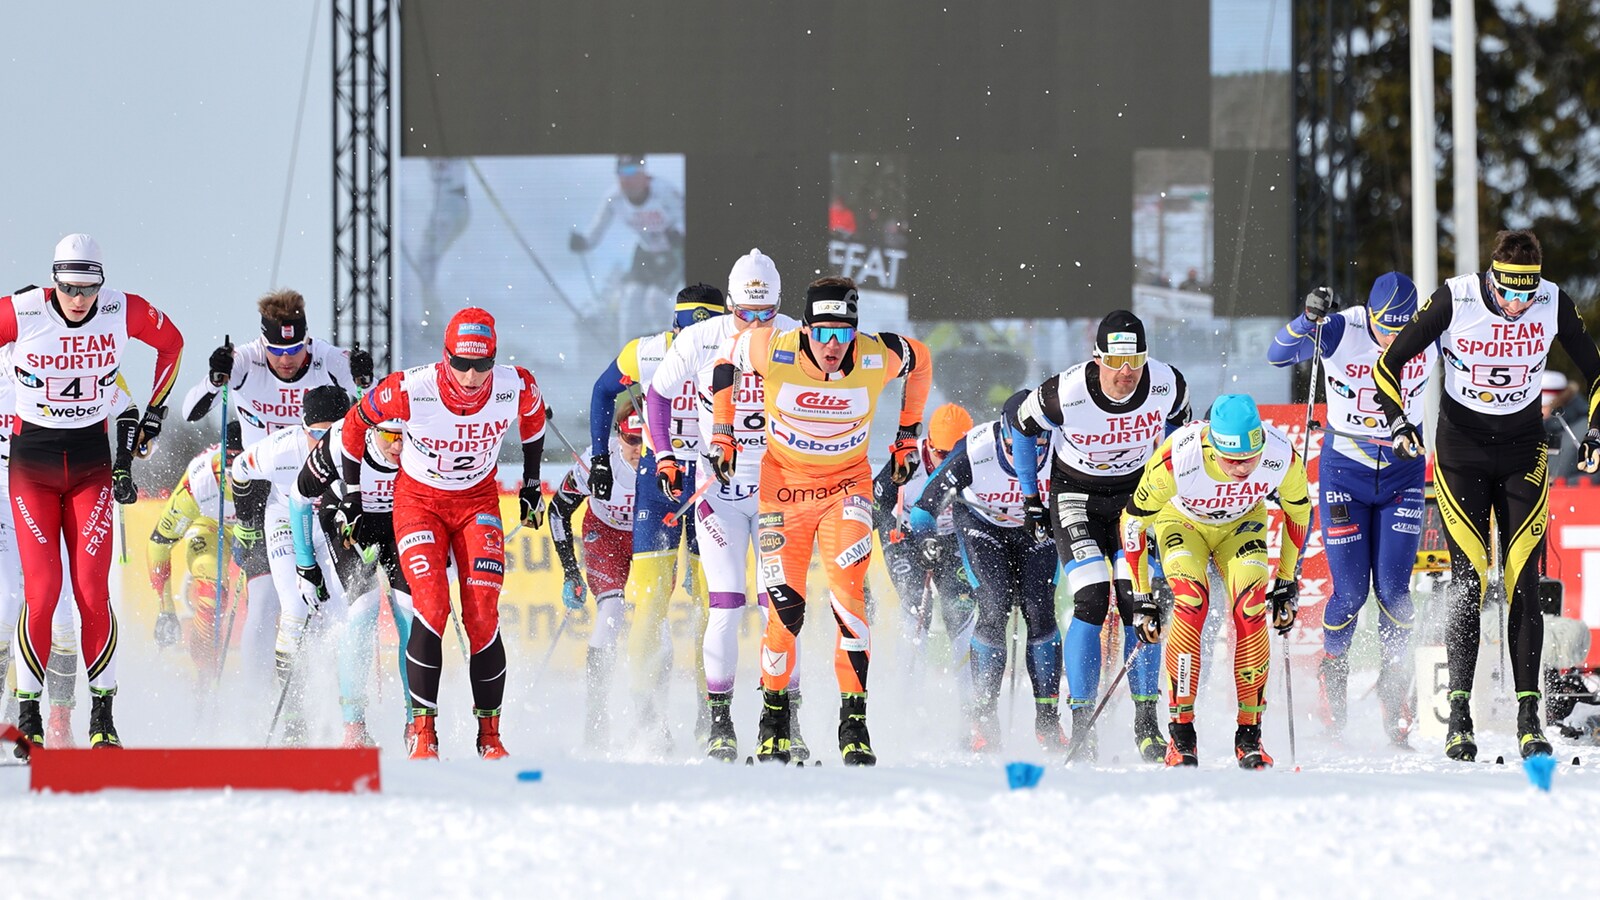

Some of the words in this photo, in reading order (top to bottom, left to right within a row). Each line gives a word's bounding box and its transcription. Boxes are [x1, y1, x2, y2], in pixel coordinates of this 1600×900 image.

[1500, 273, 1534, 287] Ilmajoki
[101, 304, 118, 312] SGN
[1384, 314, 1410, 322] EHS
[1491, 322, 1545, 340] TEAM
[60, 333, 116, 353] TEAM
[1457, 338, 1545, 357] SPORTIA
[27, 353, 116, 370] SPORTIA
[1487, 367, 1512, 386] 5
[60, 377, 83, 399] 4
[100, 389, 103, 398] 1
[495, 393, 512, 401] SGN
[796, 391, 853, 410] Calix
[50, 404, 104, 418] weber
[455, 419, 508, 439] TEAM
[743, 413, 766, 430] 6
[1106, 410, 1162, 432] TEAM
[1346, 413, 1389, 428] ISOV
[770, 420, 867, 452] Webasto
[1071, 424, 1163, 446] SPORTIA
[453, 456, 476, 470] 2
[1262, 459, 1281, 469] SGN
[1215, 482, 1269, 497] TEAM
[1326, 491, 1352, 503] EHS
[16, 496, 48, 544] noname
[703, 520, 728, 548] NATURE
[476, 561, 503, 573] MITRA
